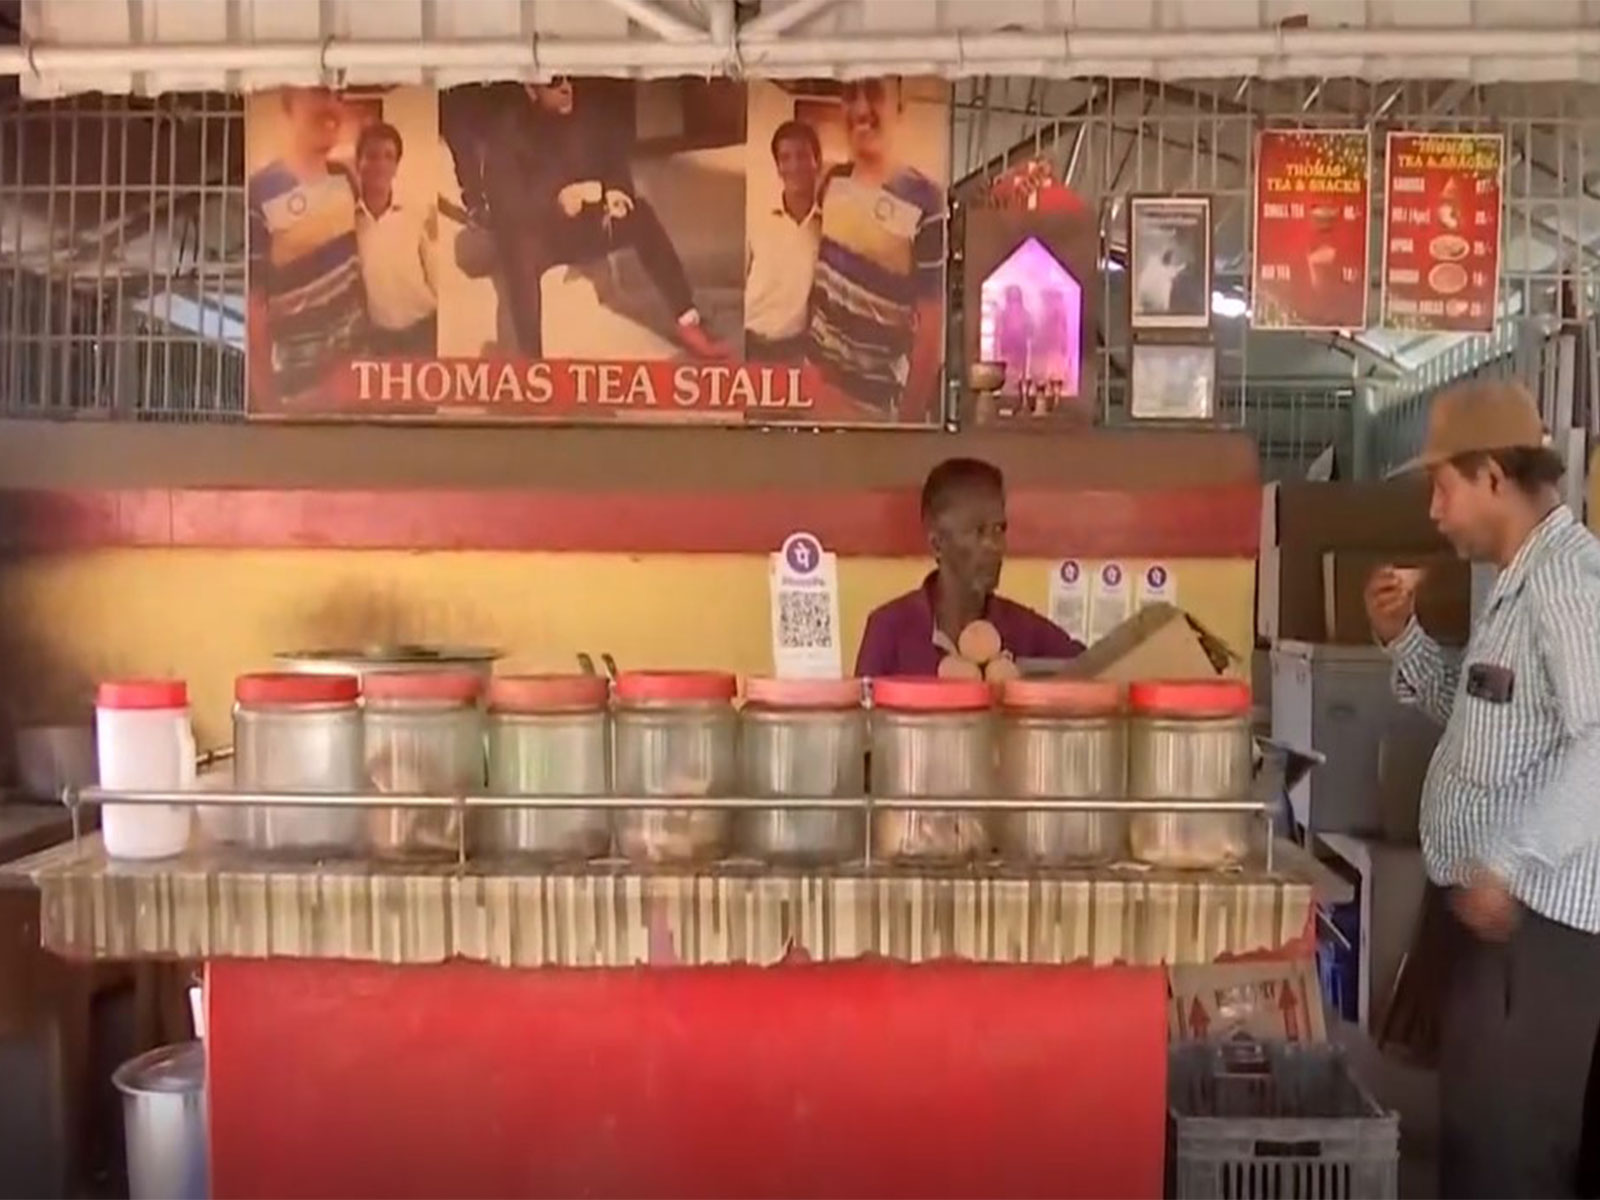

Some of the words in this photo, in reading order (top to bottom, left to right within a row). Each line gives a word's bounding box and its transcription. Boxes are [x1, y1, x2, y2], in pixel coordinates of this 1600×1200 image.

[1267, 178, 1292, 191] TEA
[1309, 178, 1361, 194] SNACKS
[351, 360, 554, 403] THOMAS
[568, 363, 657, 405] TEA
[672, 365, 814, 408] STALL
